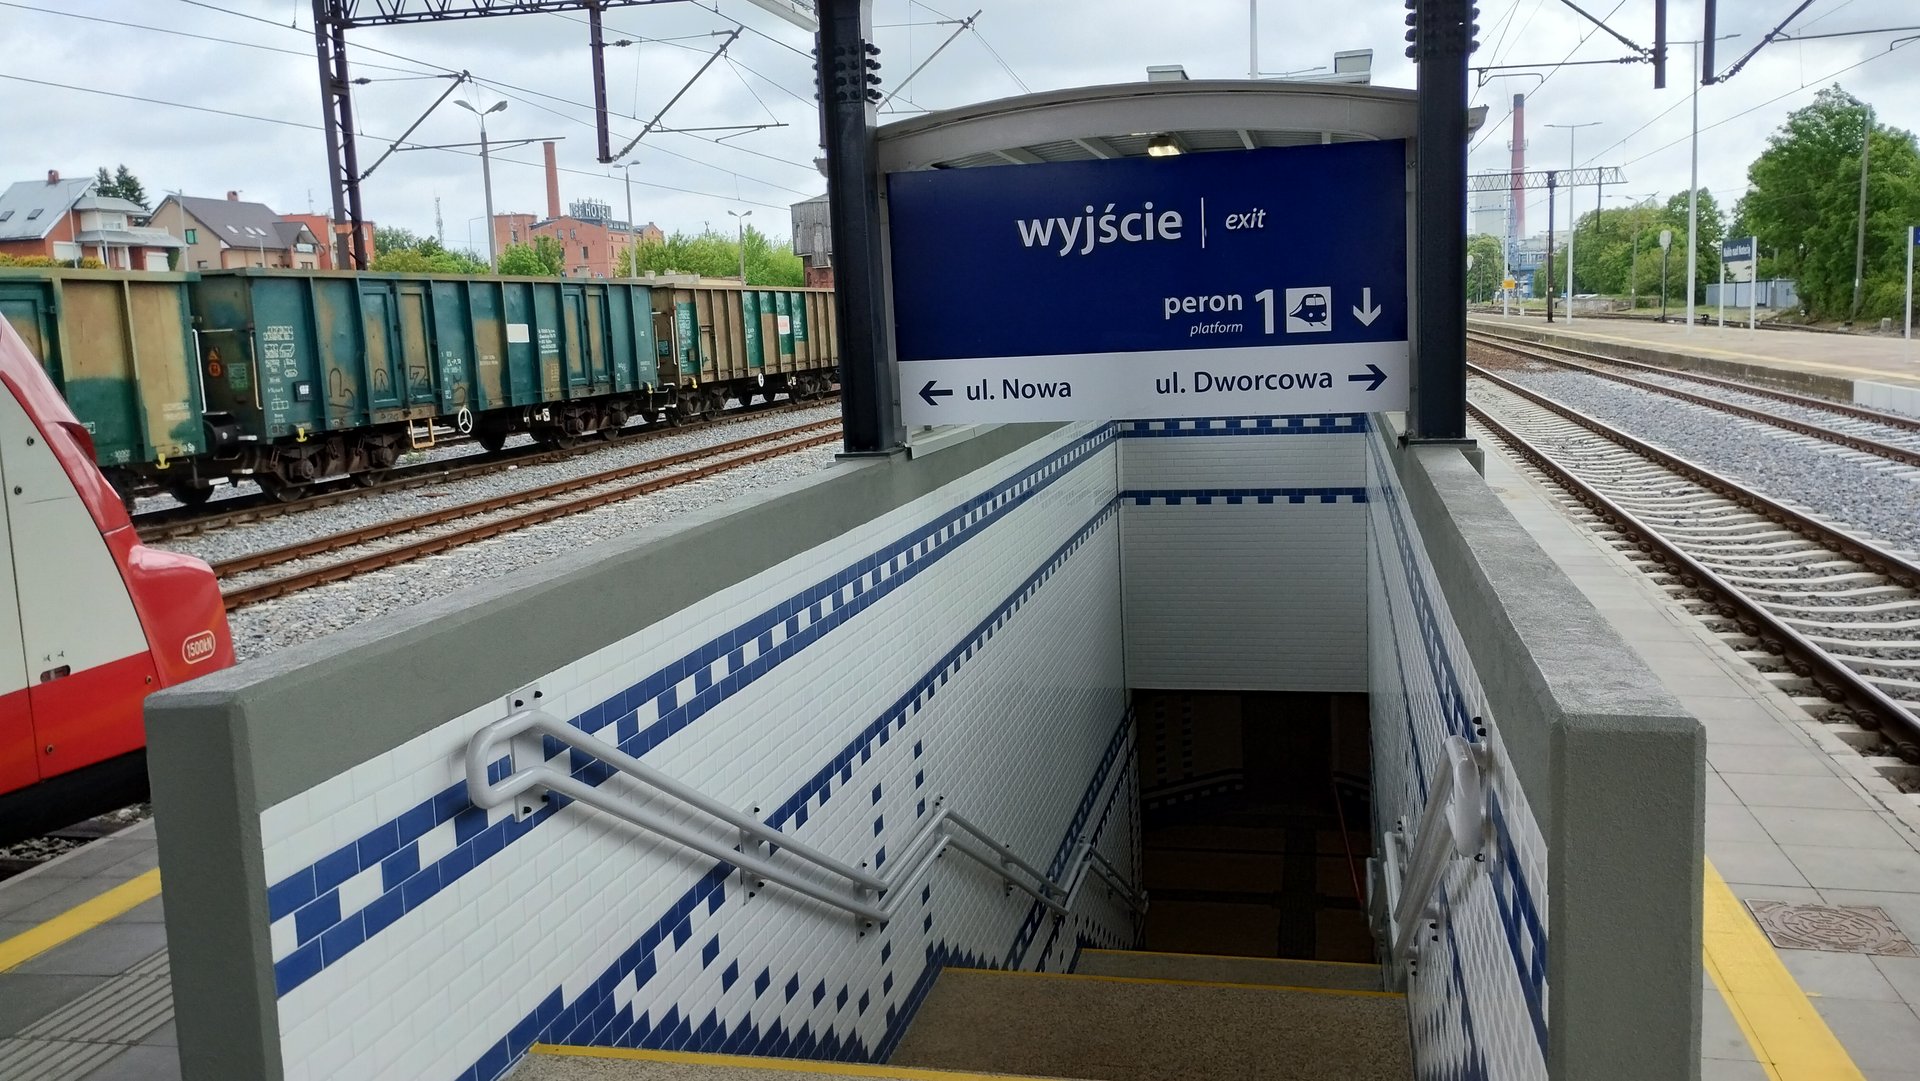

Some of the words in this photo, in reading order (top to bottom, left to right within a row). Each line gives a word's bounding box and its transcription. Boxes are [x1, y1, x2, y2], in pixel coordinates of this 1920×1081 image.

[585, 203, 611, 219] HOTEL
[1017, 201, 1183, 257] wyjście
[1225, 207, 1267, 230] exit
[1164, 293, 1243, 319] peron
[1254, 288, 1275, 335] 1
[1189, 320, 1243, 337] platform
[966, 378, 995, 401] ul.
[1002, 378, 1072, 400] Nowa
[1155, 371, 1186, 395] ul.
[1194, 370, 1333, 394] Dworcowa
